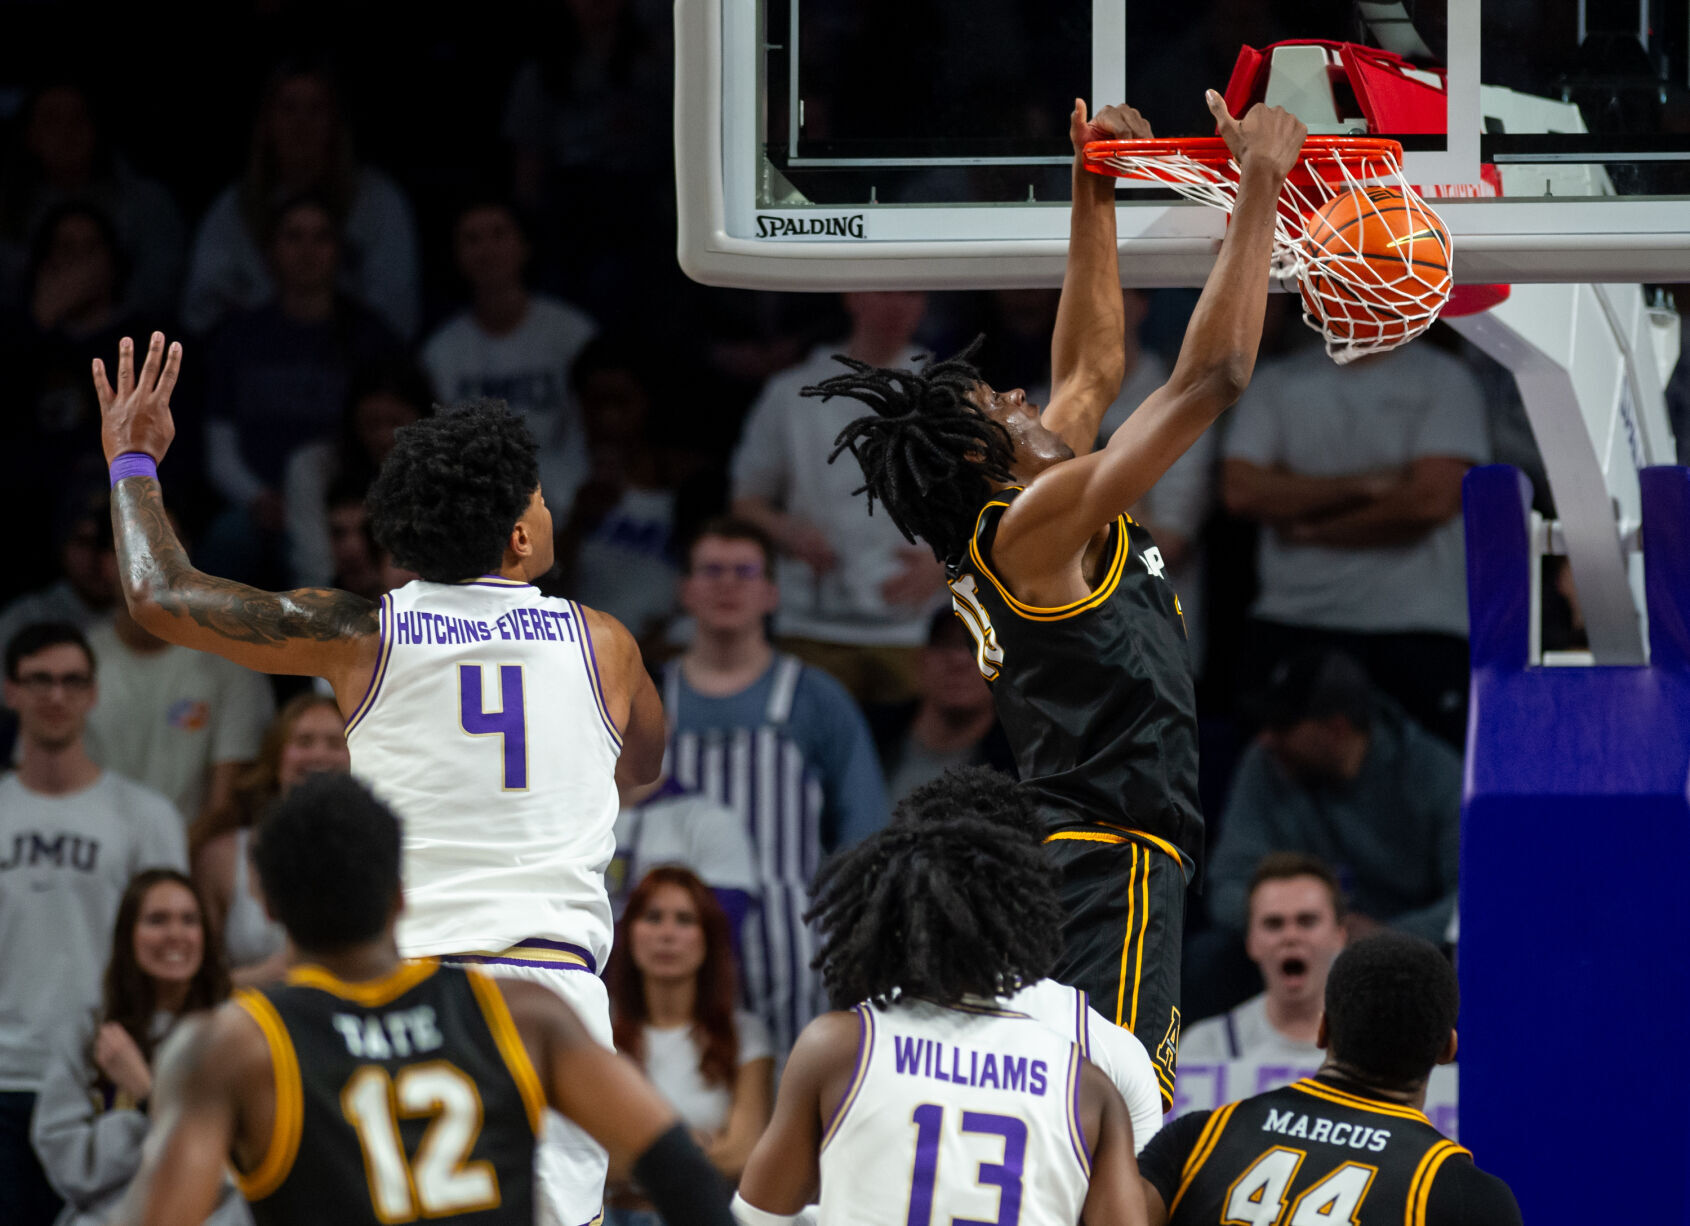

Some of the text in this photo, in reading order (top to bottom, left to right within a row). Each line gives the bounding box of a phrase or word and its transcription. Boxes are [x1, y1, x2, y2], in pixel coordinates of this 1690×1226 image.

[755, 214, 865, 238] SPALDING
[396, 608, 575, 645] HUTCHINS-EVERETT
[456, 661, 530, 792] 4
[0, 833, 101, 873] JMU
[894, 1035, 1049, 1097] WILLIAMS
[339, 1058, 502, 1225] 12
[1261, 1108, 1392, 1152] MARCUS
[905, 1101, 1029, 1226] 13
[1220, 1144, 1379, 1226] 44
